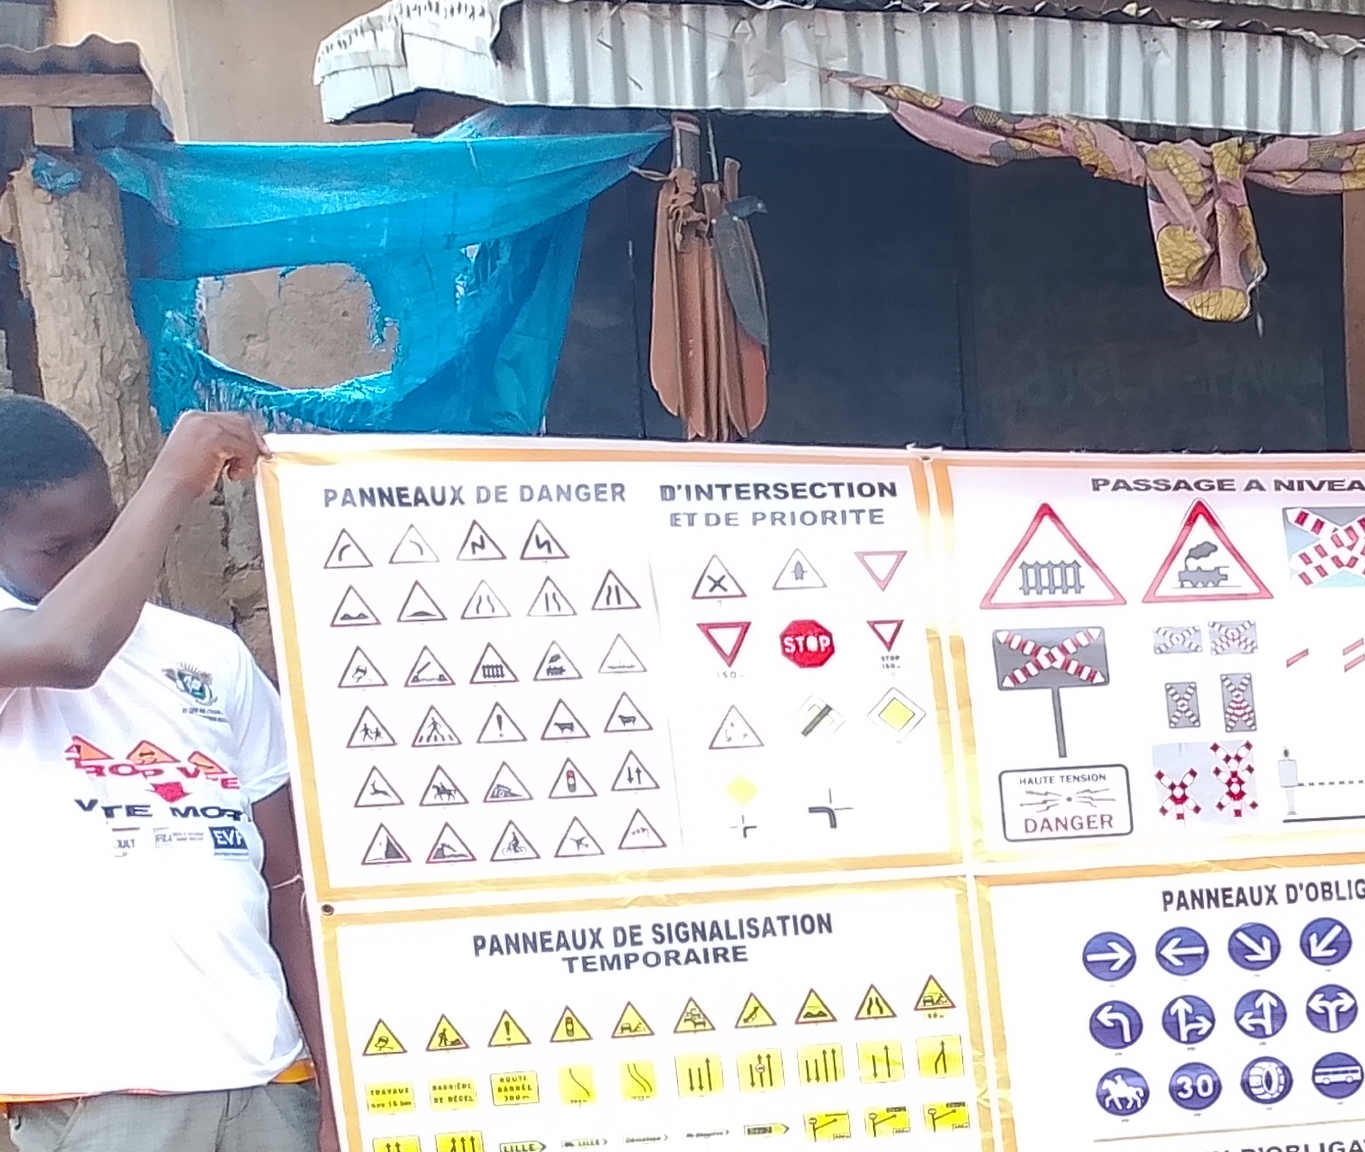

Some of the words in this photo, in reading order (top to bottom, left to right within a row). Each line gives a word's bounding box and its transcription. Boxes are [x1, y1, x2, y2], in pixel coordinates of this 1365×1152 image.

[660, 481, 898, 501] D'INTERSECTION
[1091, 478, 1236, 492] PASSAGE
[1243, 478, 1266, 492] A
[323, 485, 465, 508] PANNEAUX
[476, 485, 508, 504] DE
[519, 483, 626, 503] DANGER
[670, 512, 698, 527] ET
[704, 511, 740, 527] DE
[752, 508, 885, 527] PRIORITE
[783, 635, 831, 654] STOP
[1019, 776, 1055, 786] HAUTE
[1060, 773, 1107, 784] TENSION
[1024, 814, 1113, 834] DANGER
[1161, 884, 1279, 912] PANNEAUX
[472, 927, 605, 957] PANNEAUX
[613, 924, 643, 948] DE
[652, 912, 833, 945] SIGNALISATION
[562, 945, 748, 973] TEMPORAIRE
[1176, 1074, 1214, 1100] 30
